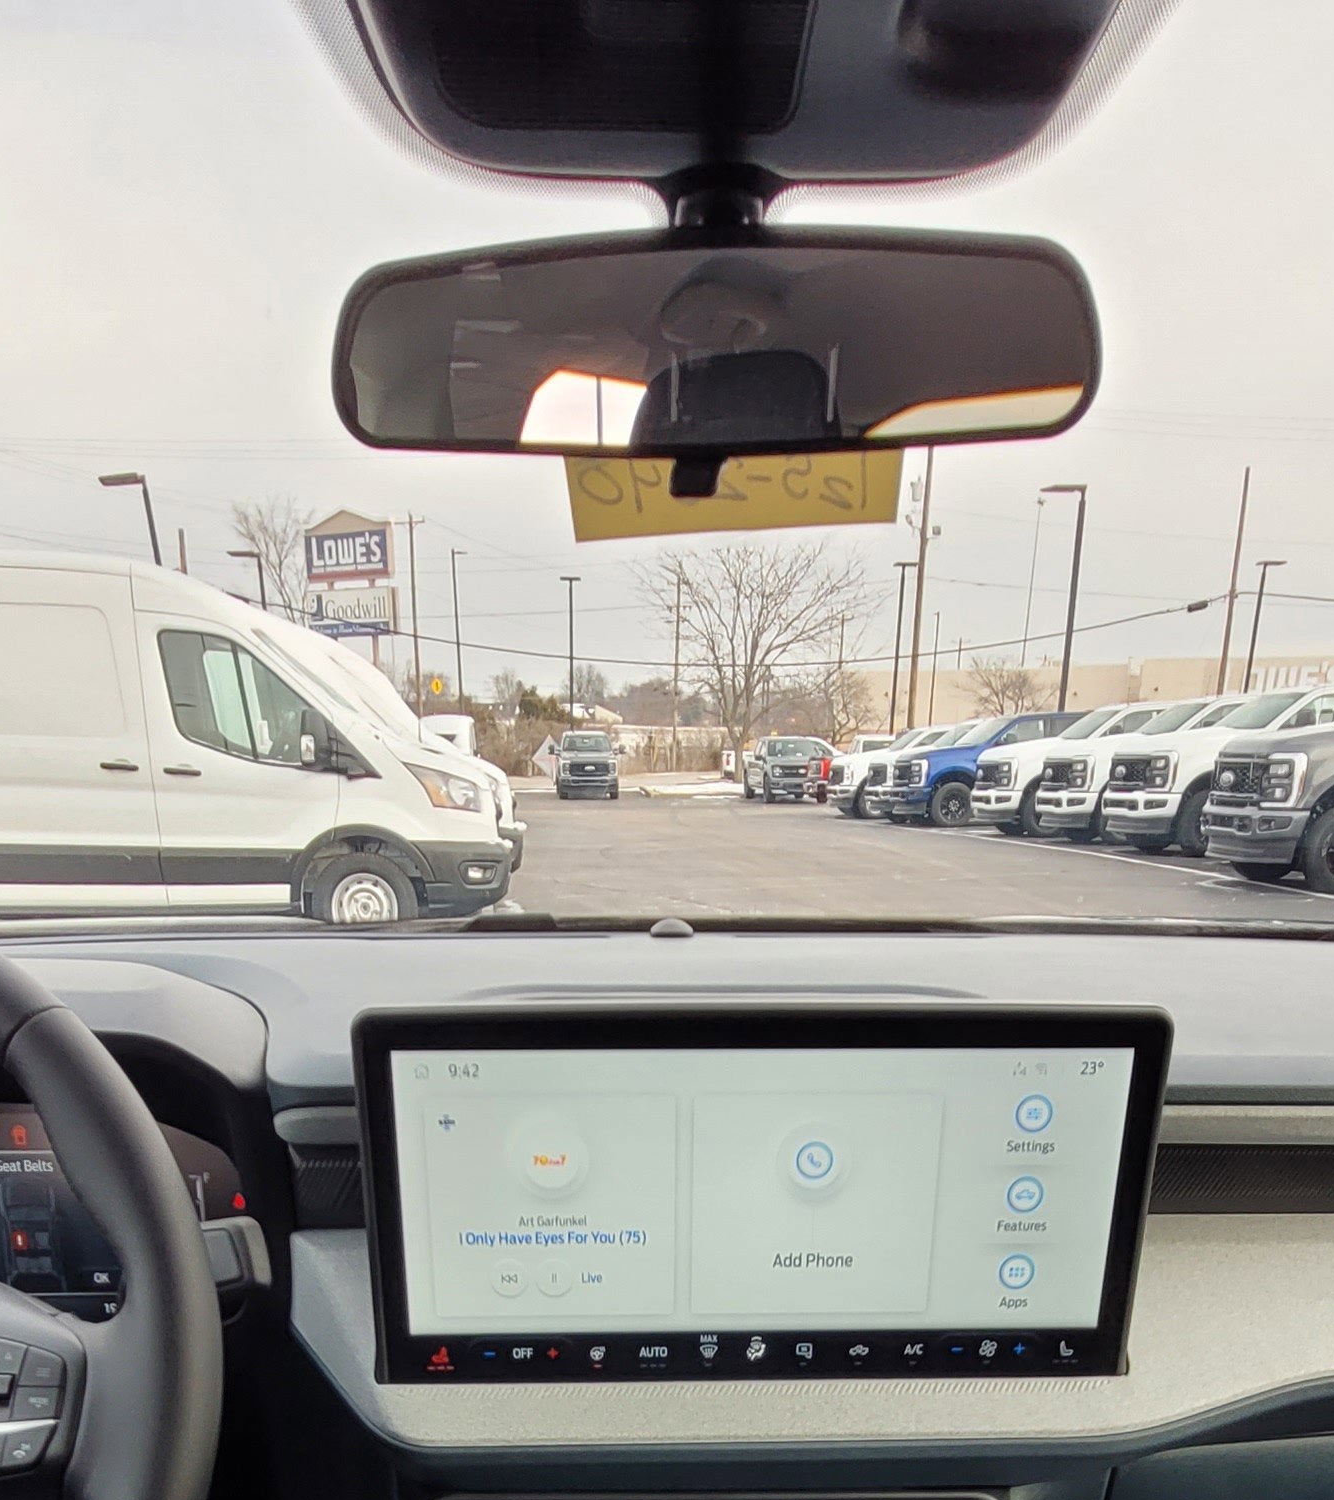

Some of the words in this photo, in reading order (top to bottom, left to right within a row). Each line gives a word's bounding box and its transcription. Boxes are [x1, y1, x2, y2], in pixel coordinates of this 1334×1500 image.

[311, 532, 382, 566] LOWE'S
[324, 596, 387, 619] Goodwill
[448, 1063, 480, 1078] 9:42
[1006, 1140, 1055, 1154] Settings
[23, 1159, 54, 1172] Belts
[519, 1216, 534, 1227] Art
[537, 1215, 587, 1227] Garfunkel
[996, 1220, 1047, 1232] Features
[466, 1232, 496, 1247] Only
[498, 1232, 532, 1245] Have
[535, 1231, 565, 1246] Eyes
[567, 1231, 588, 1244] For
[591, 1231, 616, 1244] You
[619, 1230, 647, 1246] (75)
[772, 1252, 802, 1268] Add
[805, 1252, 854, 1268] Phone
[581, 1272, 603, 1284] Live
[999, 1297, 1028, 1309] Apps
[700, 1334, 718, 1343] MAX
[512, 1347, 533, 1359] OFF
[639, 1346, 668, 1358] AUTO
[904, 1343, 924, 1355] A/C
